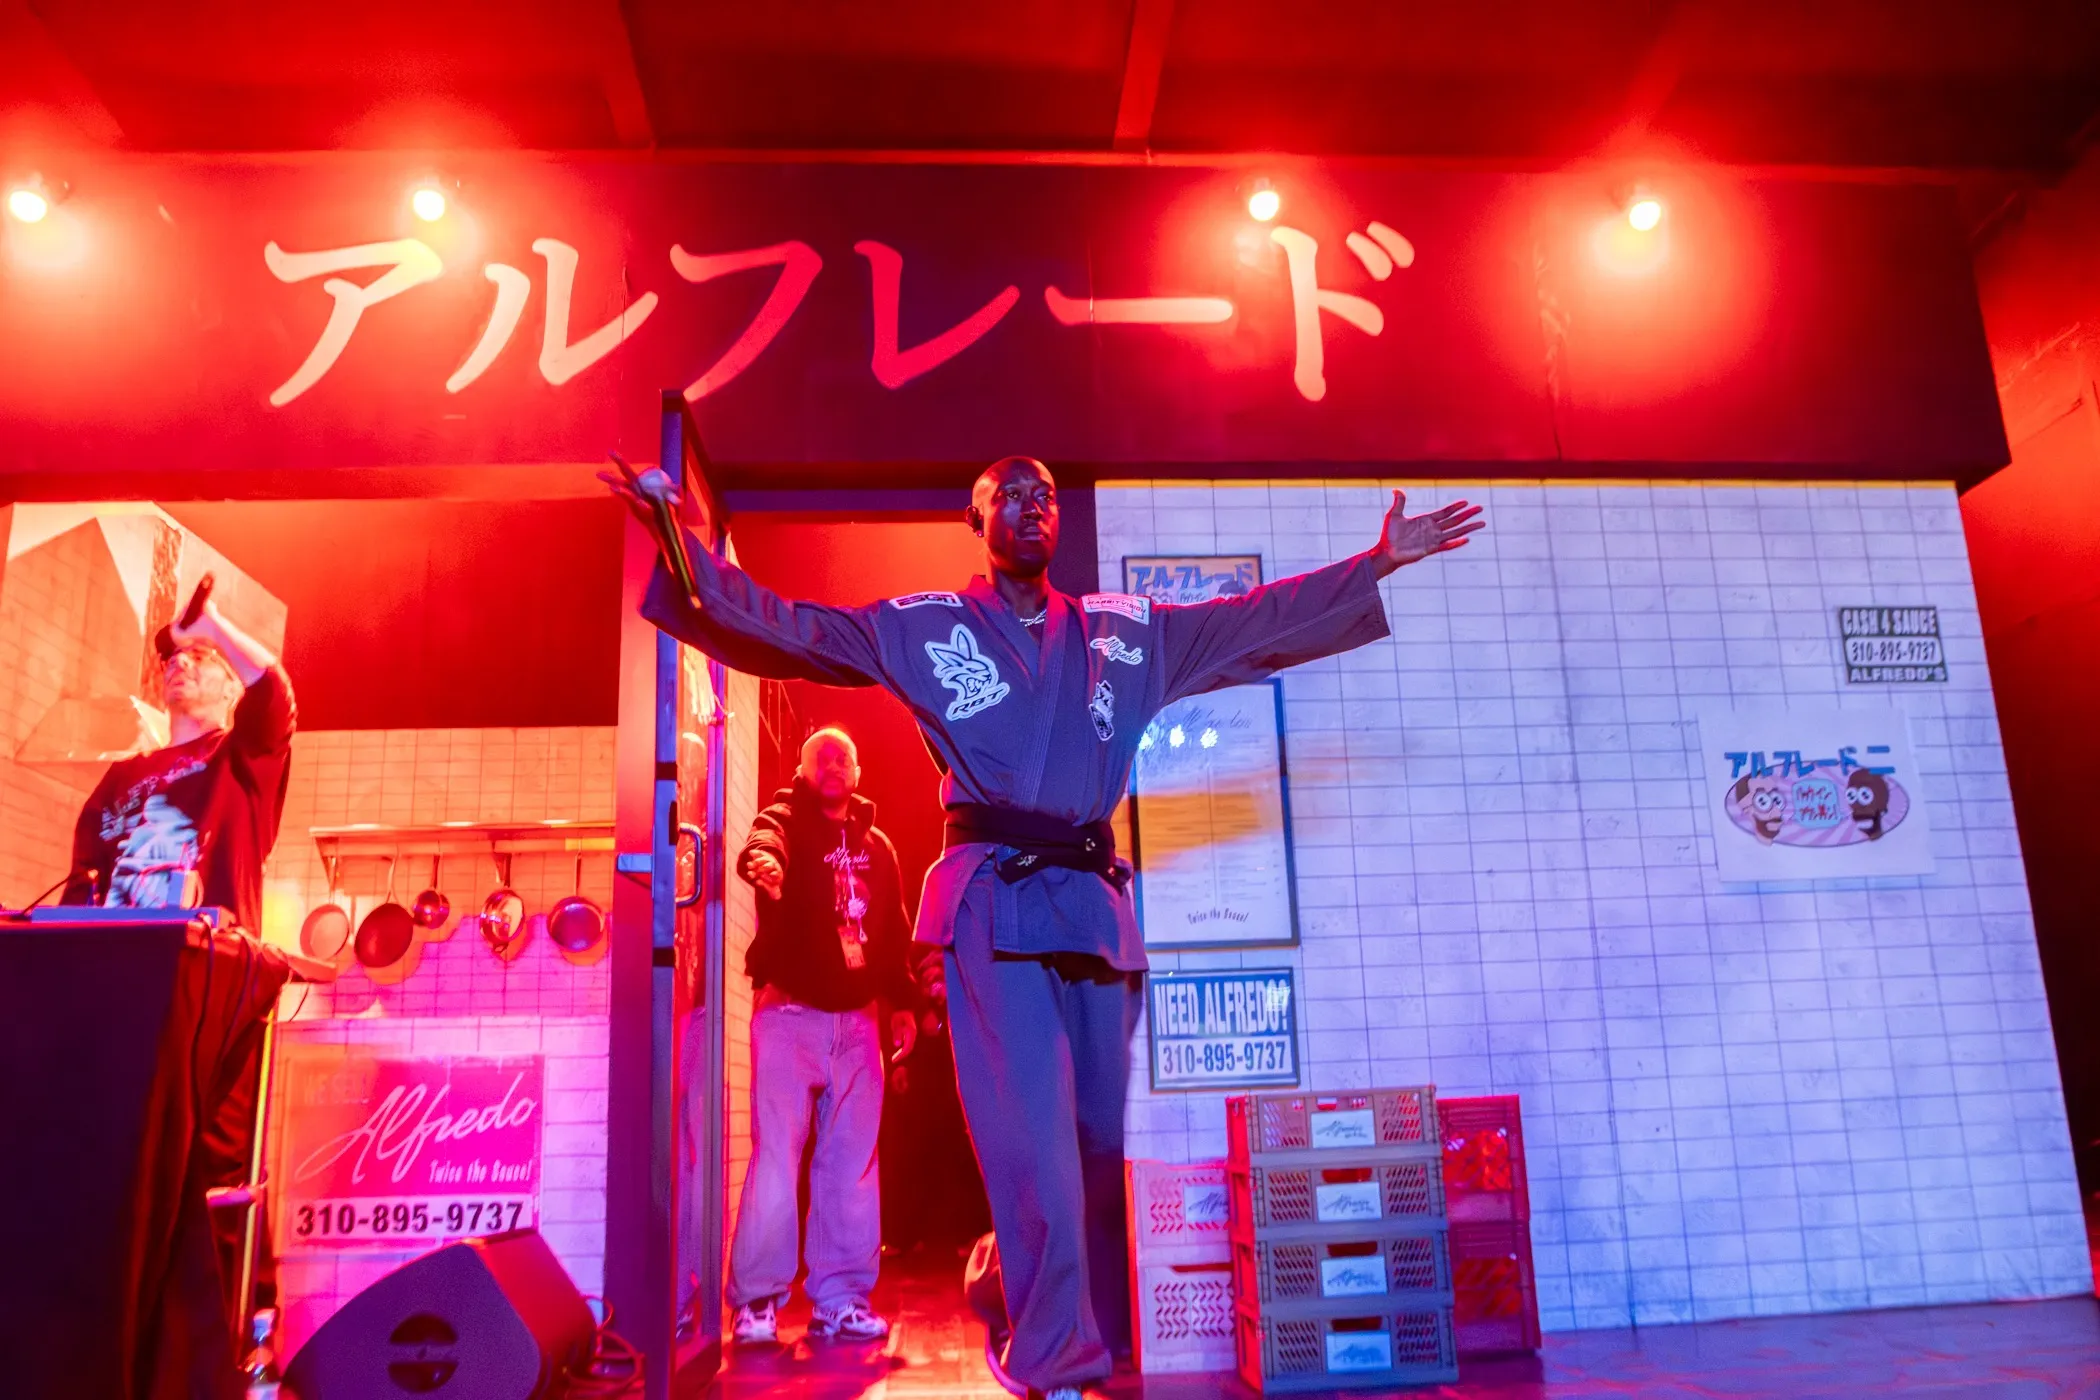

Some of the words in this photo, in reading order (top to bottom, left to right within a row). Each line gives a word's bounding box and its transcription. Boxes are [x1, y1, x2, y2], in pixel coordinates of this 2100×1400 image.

[264, 221, 1415, 407] アルフレード
[1842, 609, 1879, 635] CASH
[1892, 608, 1937, 635] SAUCE
[1093, 638, 1140, 663] Alfredo
[1852, 641, 1935, 661] 310-895-9737
[952, 689, 1005, 715] RBT
[1154, 982, 1199, 1036] NEED
[1204, 978, 1291, 1034] ALFREDO?
[1163, 1040, 1286, 1075] 310-895-9737
[295, 1071, 538, 1185] Alfredo
[467, 1159, 487, 1184] the
[297, 1202, 524, 1236] 310-895-9737
